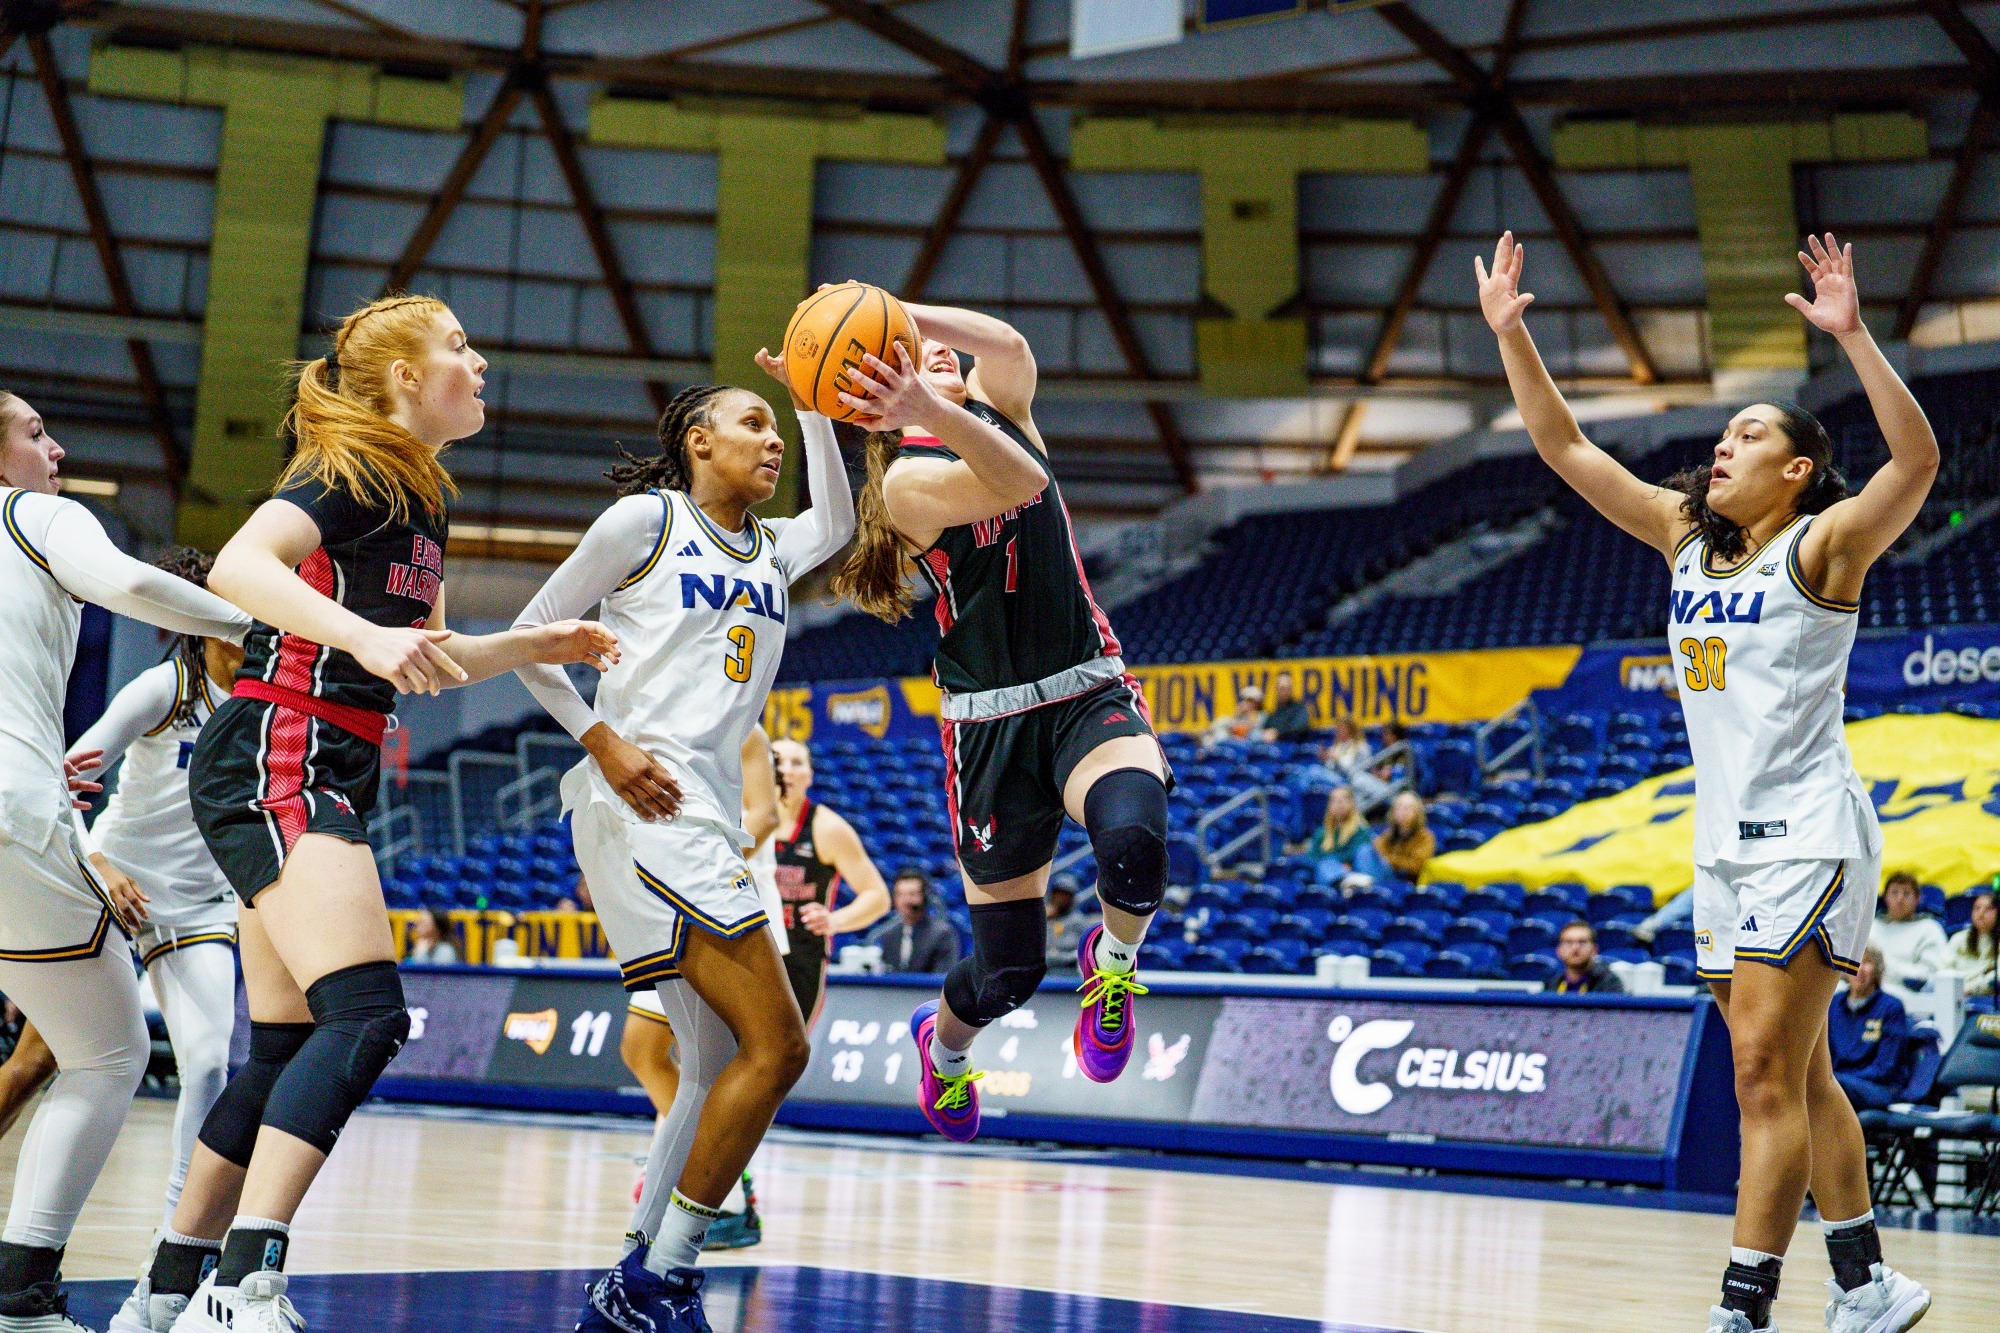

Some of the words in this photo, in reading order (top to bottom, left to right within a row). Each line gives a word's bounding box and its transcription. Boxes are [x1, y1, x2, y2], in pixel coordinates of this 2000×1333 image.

[678, 573, 785, 626] NAU
[1668, 589, 1766, 624] NAU
[724, 625, 755, 683] 3
[1680, 636, 1727, 691] 30
[1233, 662, 1427, 720] WRNING
[569, 1010, 612, 1056] 11
[884, 1053, 903, 1084] 1
[1060, 1036, 1088, 1079] 1
[1396, 1048, 1548, 1093] CELSIUS
